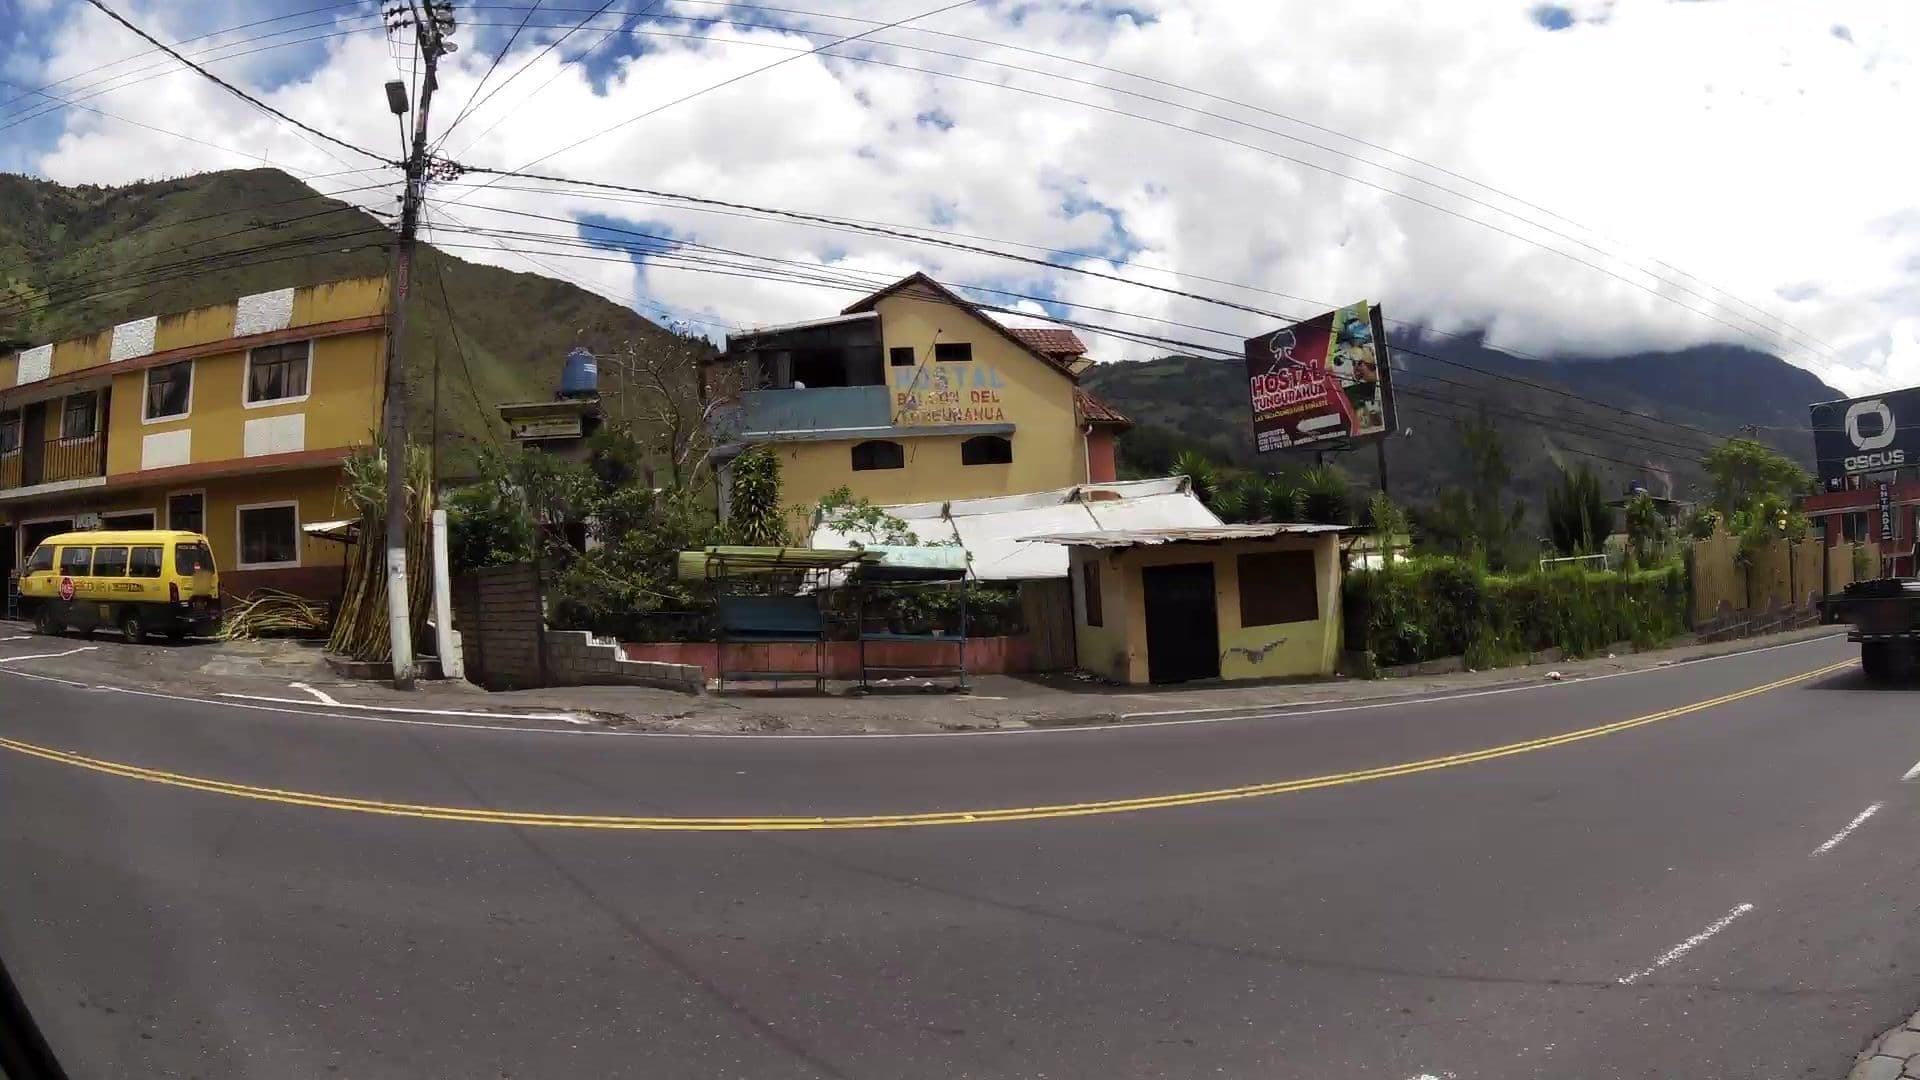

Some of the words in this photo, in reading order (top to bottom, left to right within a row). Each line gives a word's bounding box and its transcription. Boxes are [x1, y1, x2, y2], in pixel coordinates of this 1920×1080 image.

[1251, 359, 1327, 397] HOSTAL
[970, 390, 1000, 403] DEL
[1844, 450, 1904, 471] OSCUS
